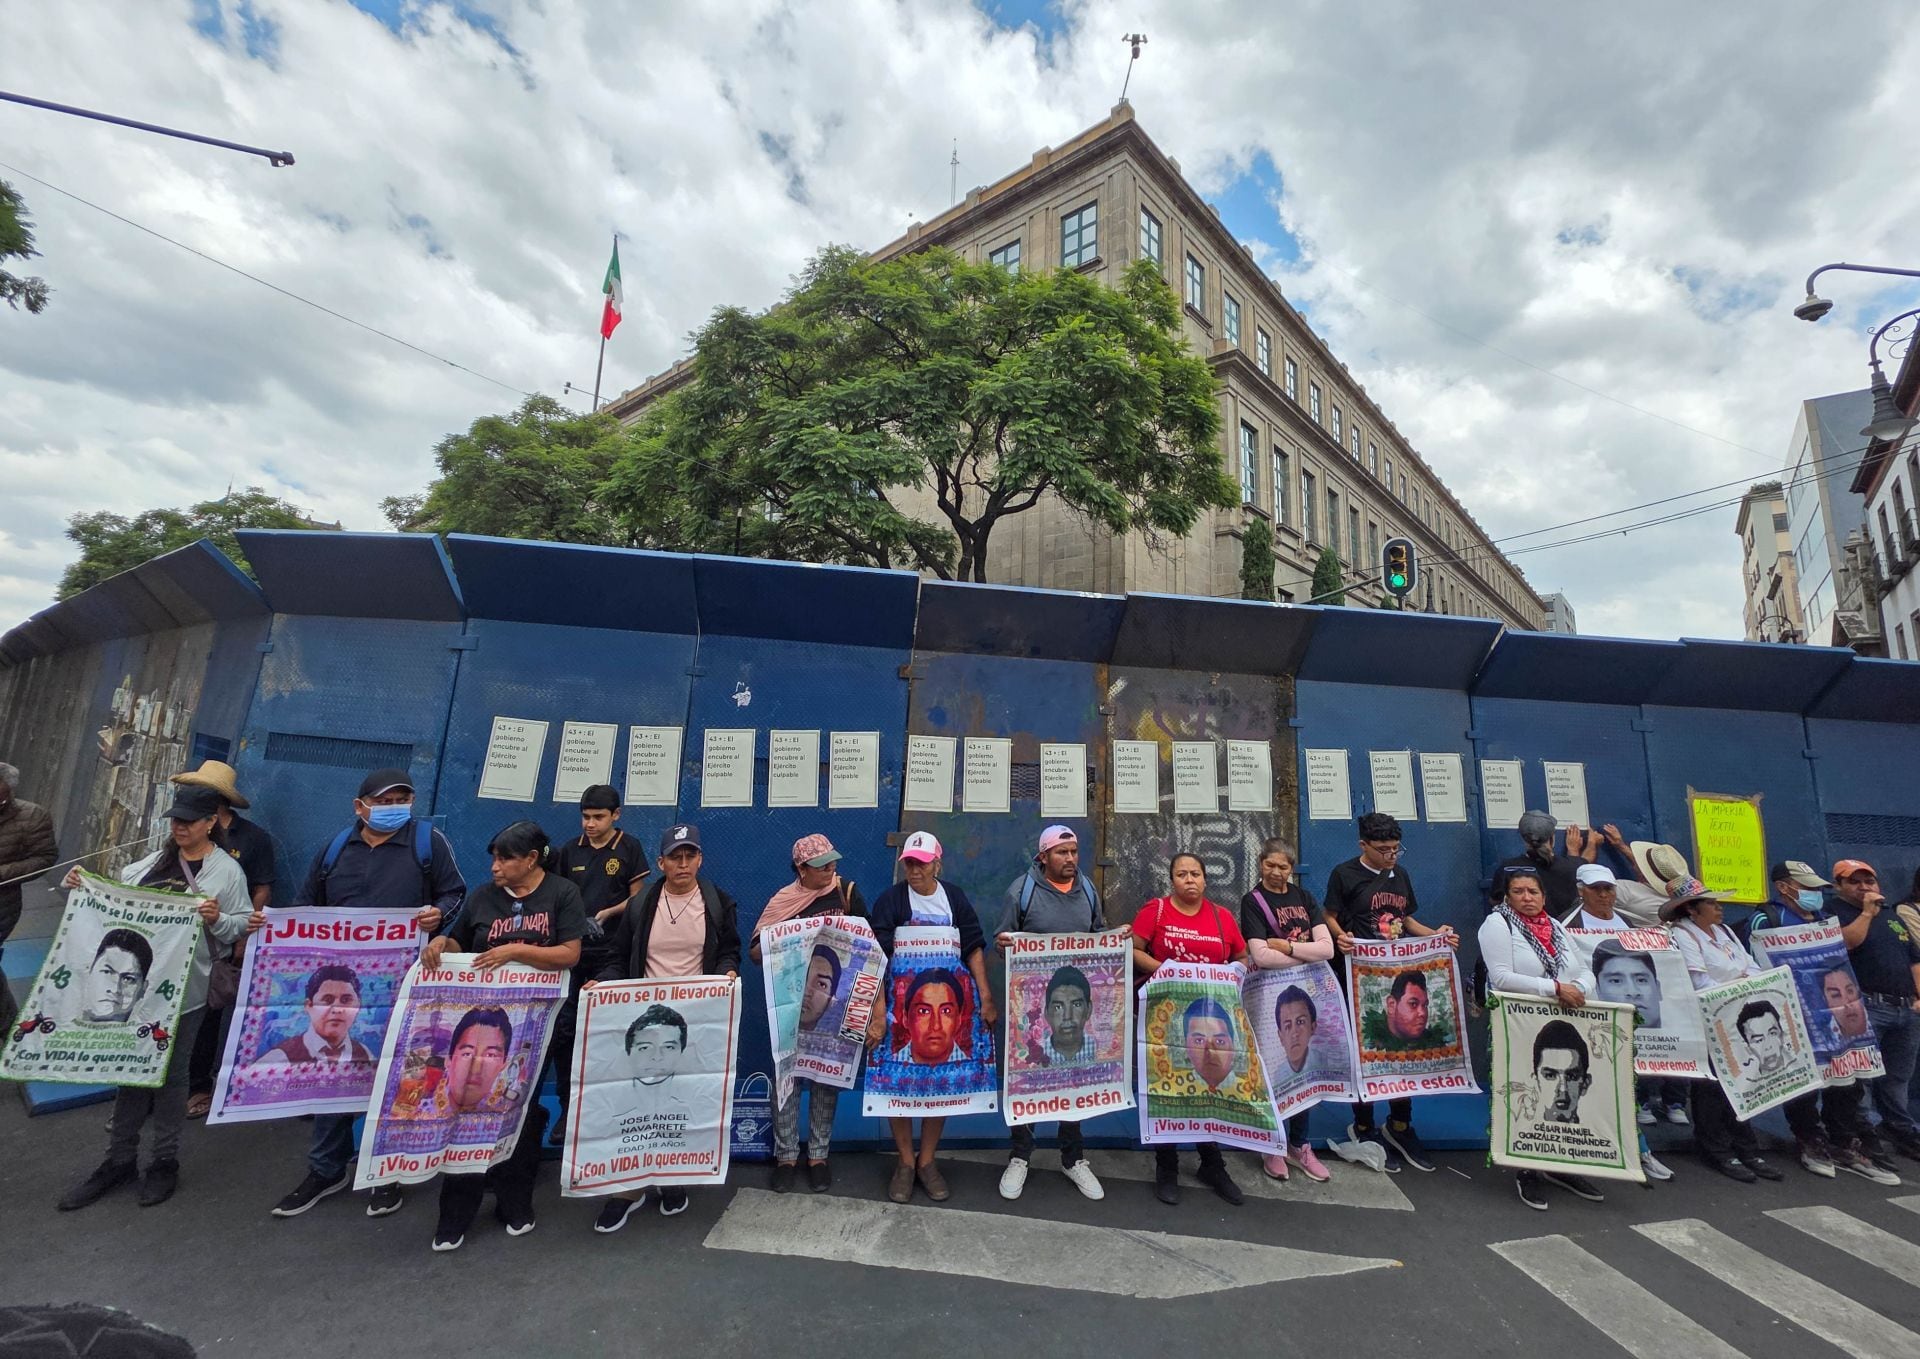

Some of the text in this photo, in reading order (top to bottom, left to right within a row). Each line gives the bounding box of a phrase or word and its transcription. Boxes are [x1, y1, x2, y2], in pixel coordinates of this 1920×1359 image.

[492, 742, 520, 751] encubre
[494, 733, 525, 744] gobierno
[633, 742, 662, 750] gobierno
[490, 751, 517, 761] Ejército
[910, 758, 934, 766] encubre
[911, 750, 938, 759] gobierno
[488, 760, 518, 770] culpable
[630, 768, 658, 776] culpable
[909, 775, 934, 783] culpable
[79, 896, 194, 926] ¡Vivo se lo llevaron!
[264, 918, 418, 944] ¡Justicia!
[487, 911, 550, 942] AYOTINAPA
[770, 916, 833, 942] ¡Vivo se lo
[910, 937, 929, 947] vivo
[931, 939, 942, 947] se
[942, 937, 952, 947] lo
[1012, 934, 1124, 955] ¡Nos faltan 43!
[1762, 929, 1823, 949] ¡Vivo se lo
[1351, 943, 1387, 958] ¡Nos
[1391, 941, 1427, 956] faltan
[50, 964, 72, 989] 43
[414, 967, 561, 985] ¡Vivo se lo llevaron!
[1178, 968, 1207, 980] se lo
[155, 979, 176, 1001] 43
[1705, 988, 1728, 1004] ¡Vivo
[1728, 984, 1741, 995] se
[1740, 980, 1750, 993] lo
[1749, 972, 1782, 991] llevaron!
[592, 985, 730, 1008] ¡Vivo se lo llevaron!
[846, 973, 880, 1033] NOS FALTAN
[1507, 1003, 1609, 1021] ¡Vivo se lo llevaron!
[52, 1030, 137, 1041] JORGE ANTONIO
[43, 1040, 82, 1050] TIZAPA
[1645, 1043, 1677, 1051] GARCÍA
[14, 1049, 152, 1065] ¡Con VIDA lo queremos!
[1370, 1062, 1394, 1071] ISRAEL
[1636, 1059, 1698, 1073] lo queremos!
[1366, 1079, 1417, 1096] Dónde
[1421, 1072, 1466, 1089] están
[1295, 1082, 1345, 1103] queremos!
[888, 1097, 971, 1110] ¡Vivo lo queremos!
[1012, 1088, 1122, 1117] Dónde están
[621, 1122, 687, 1135] NAVARRETE
[622, 1129, 683, 1144] GONZÁLEZ
[1154, 1118, 1272, 1143] ¡Vivo lo queremos!
[1533, 1122, 1594, 1137] CÉSAR MANUEL
[1518, 1130, 1611, 1148] GONZÁLEZ HERNÁNDEZ
[617, 1140, 687, 1155] EDAD 18 AÑOS
[1512, 1140, 1617, 1160] ¡Con VIDA lo queremos!
[379, 1152, 441, 1176] ¡Vivo lo
[578, 1150, 715, 1181] ¡Con VIDA lo queremos!
